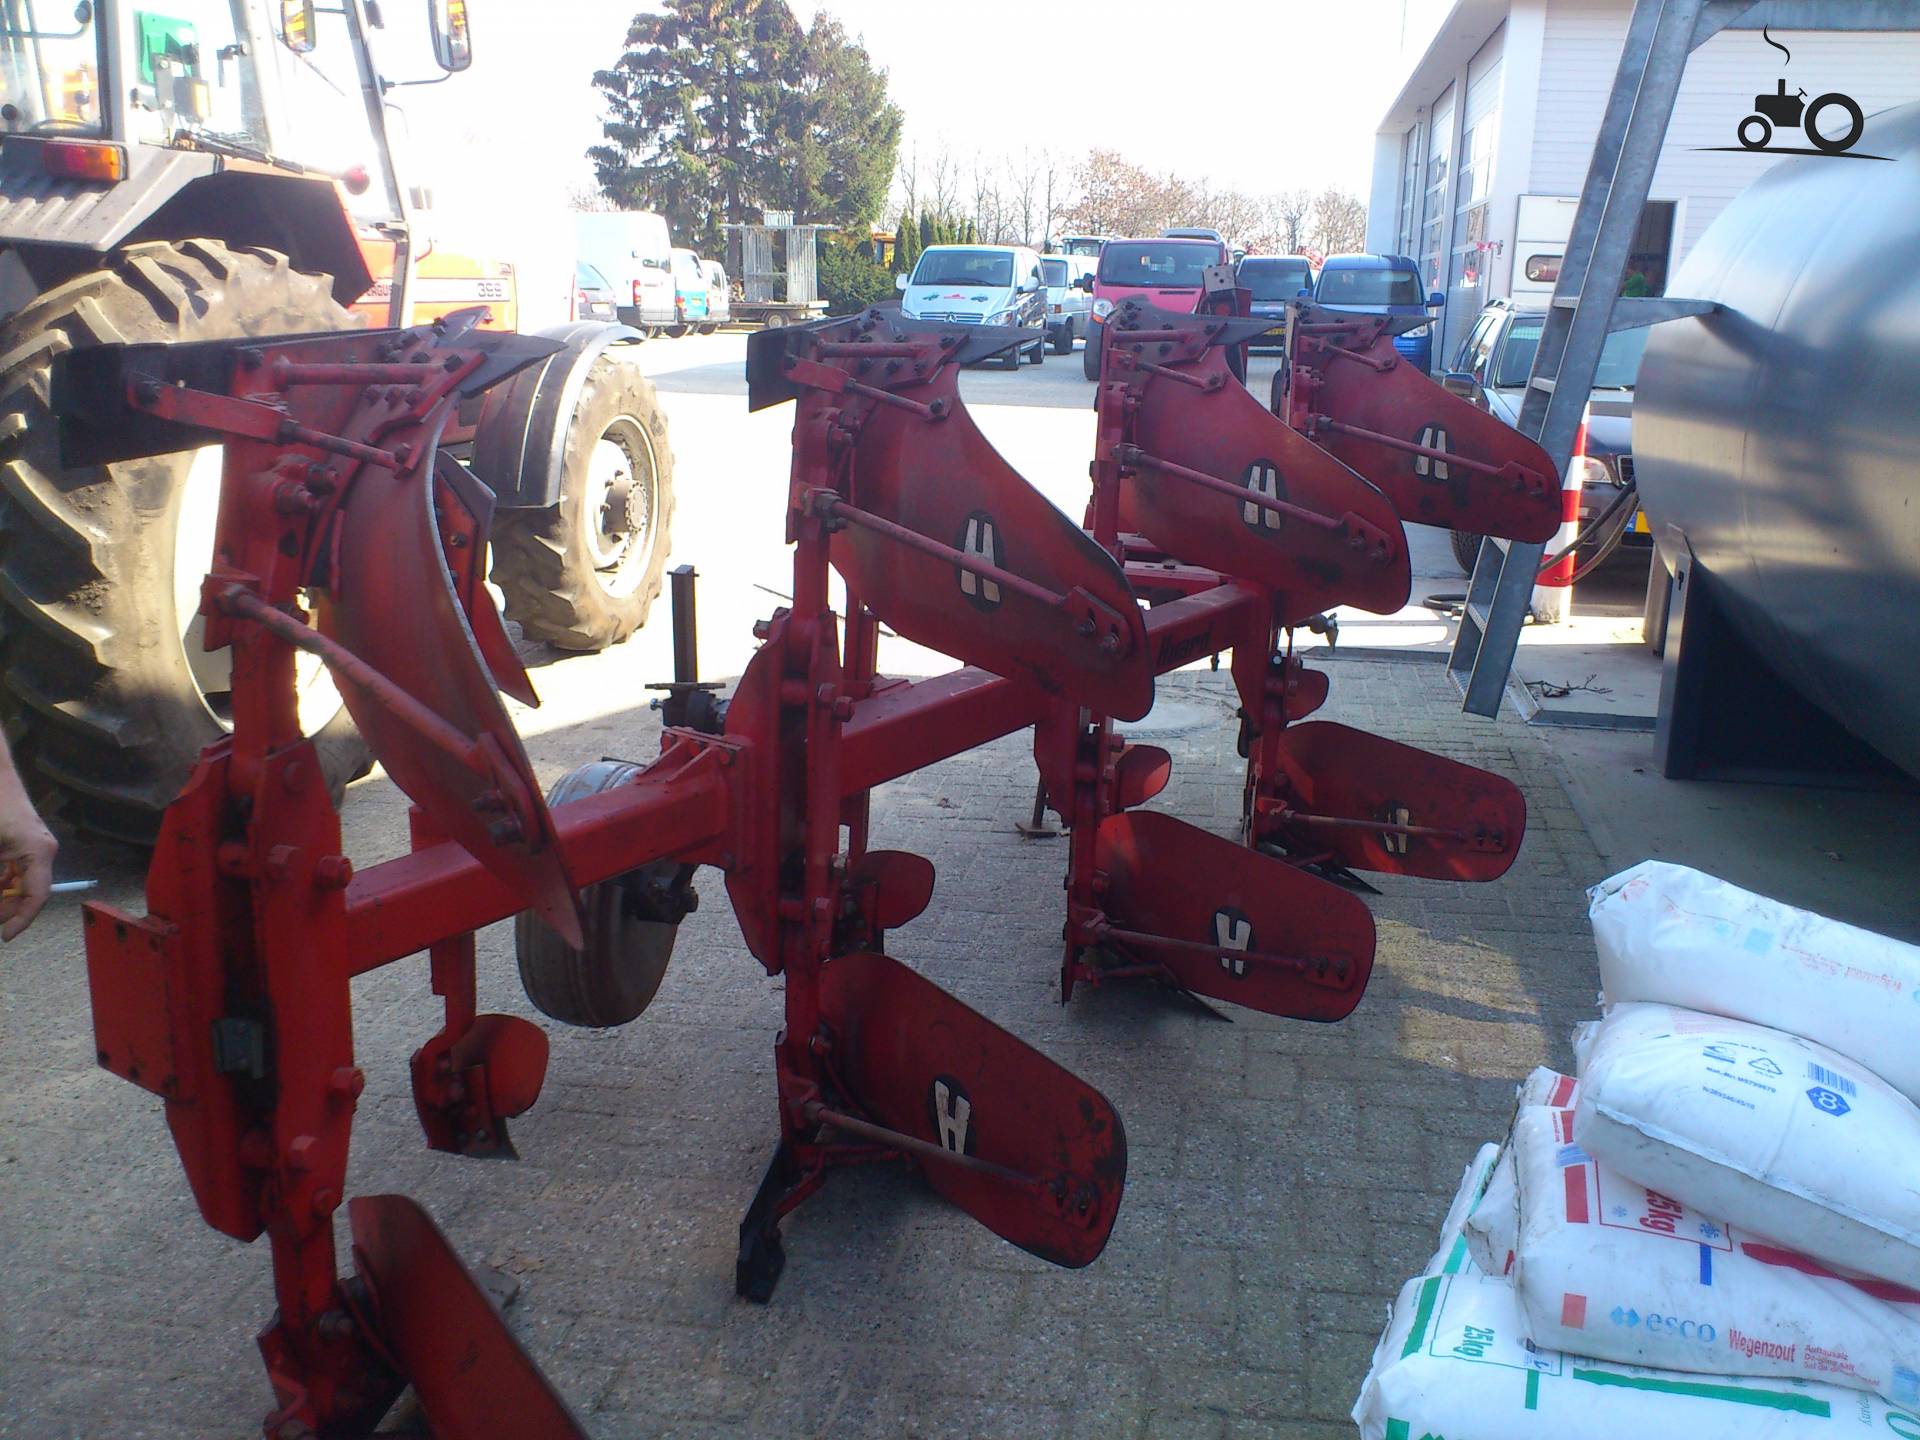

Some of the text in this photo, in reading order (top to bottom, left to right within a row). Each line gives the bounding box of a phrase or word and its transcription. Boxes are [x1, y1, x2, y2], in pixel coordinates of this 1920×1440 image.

[477, 282, 502, 298] 399
[1453, 1325, 1495, 1357] 25kg
[1646, 1312, 1716, 1343] esco
[1728, 1327, 1797, 1363] Wegenzout
